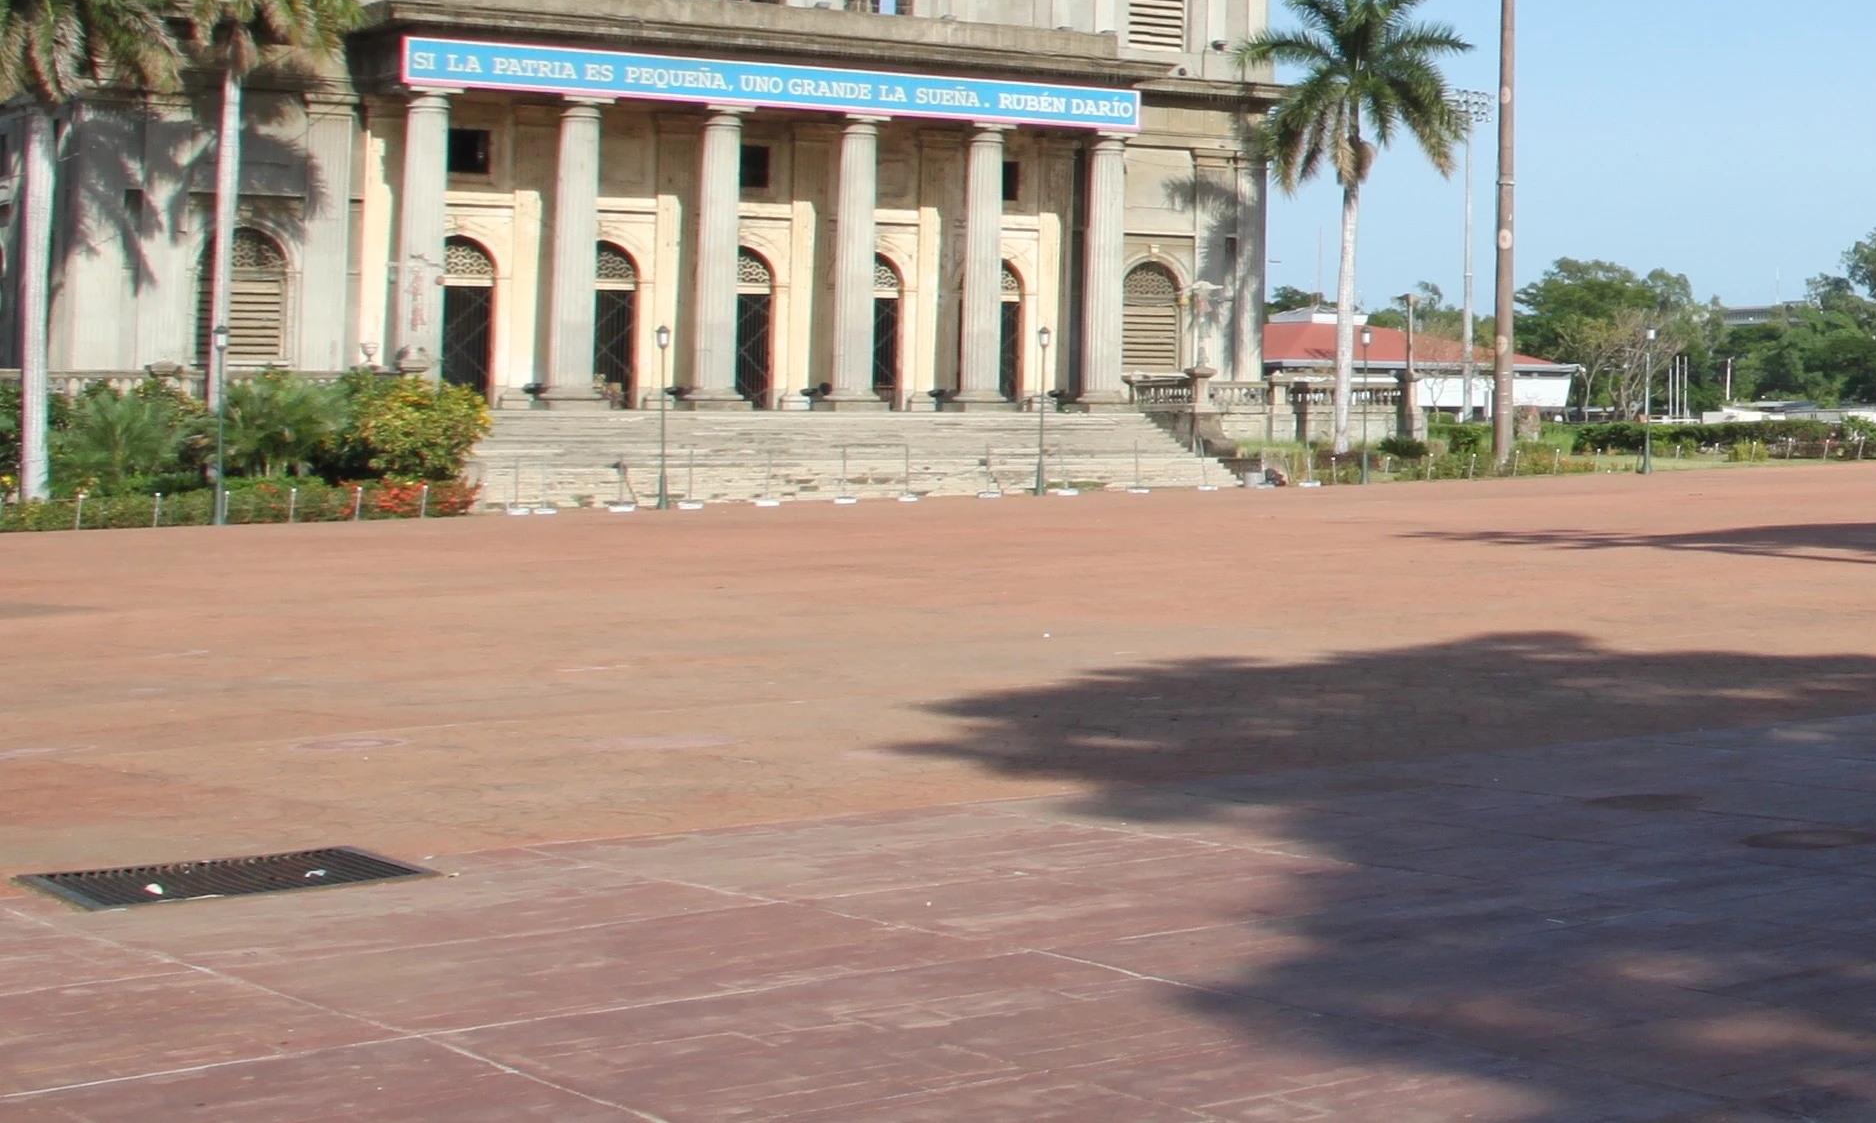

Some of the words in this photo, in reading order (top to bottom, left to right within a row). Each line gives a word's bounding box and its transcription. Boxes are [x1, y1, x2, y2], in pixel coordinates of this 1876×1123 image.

[412, 51, 436, 71] SI
[447, 54, 483, 74] LA
[493, 57, 577, 80] PATRIA
[584, 63, 614, 83] ES
[625, 66, 733, 92] PEQUEÑA,
[740, 75, 784, 95] UNO
[788, 79, 872, 101] GRANDE
[879, 84, 908, 103] LA
[998, 90, 1067, 114] RUBÉN
[1070, 95, 1134, 119] DARÍO
